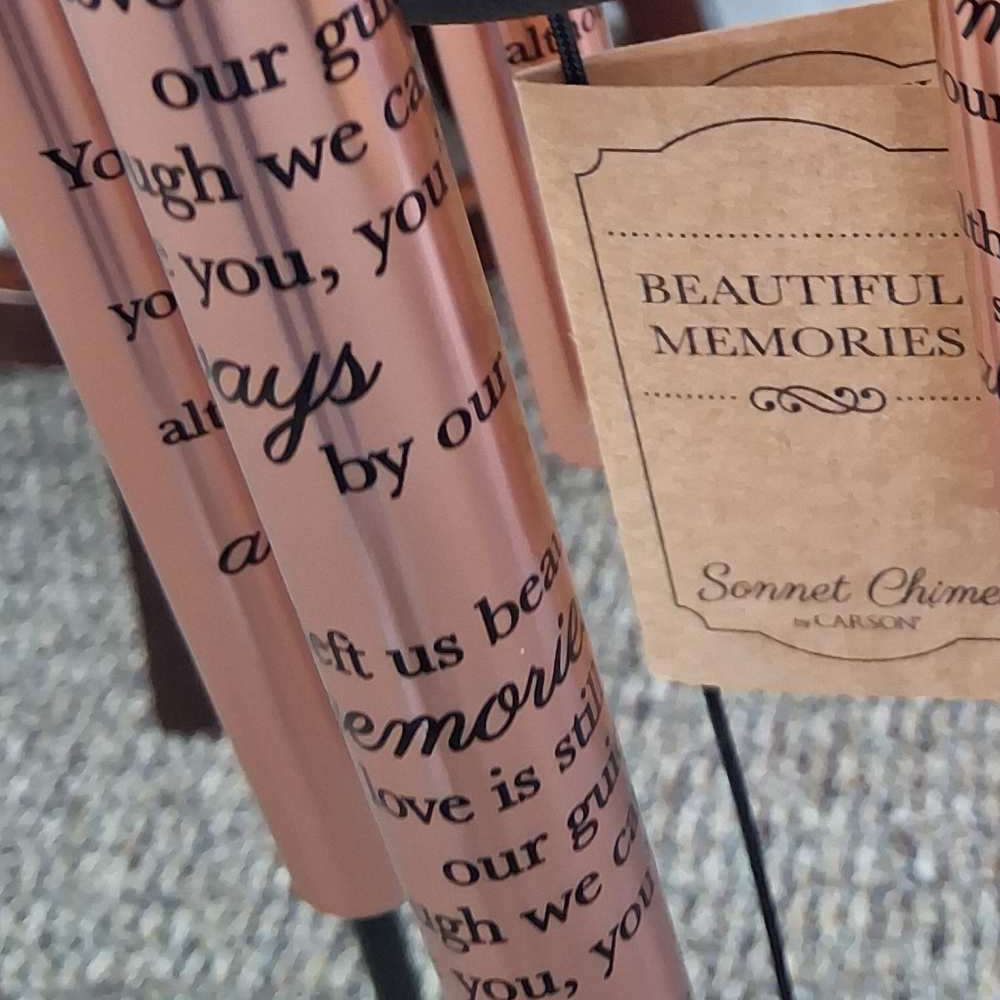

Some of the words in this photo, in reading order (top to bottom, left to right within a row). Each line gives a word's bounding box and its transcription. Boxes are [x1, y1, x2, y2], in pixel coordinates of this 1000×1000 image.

[152, 42, 288, 110] our
[257, 118, 368, 190] we
[178, 249, 339, 308] you,
[353, 160, 449, 277] you
[636, 272, 964, 307] BEAUTIFUL
[648, 324, 966, 358] MEMORIES
[320, 437, 413, 499] by
[437, 351, 507, 451] our
[698, 561, 853, 603] Sonnet
[385, 632, 464, 678] us
[490, 766, 541, 813] is
[442, 832, 548, 887] our
[520, 871, 603, 934] we
[589, 869, 655, 980] you
